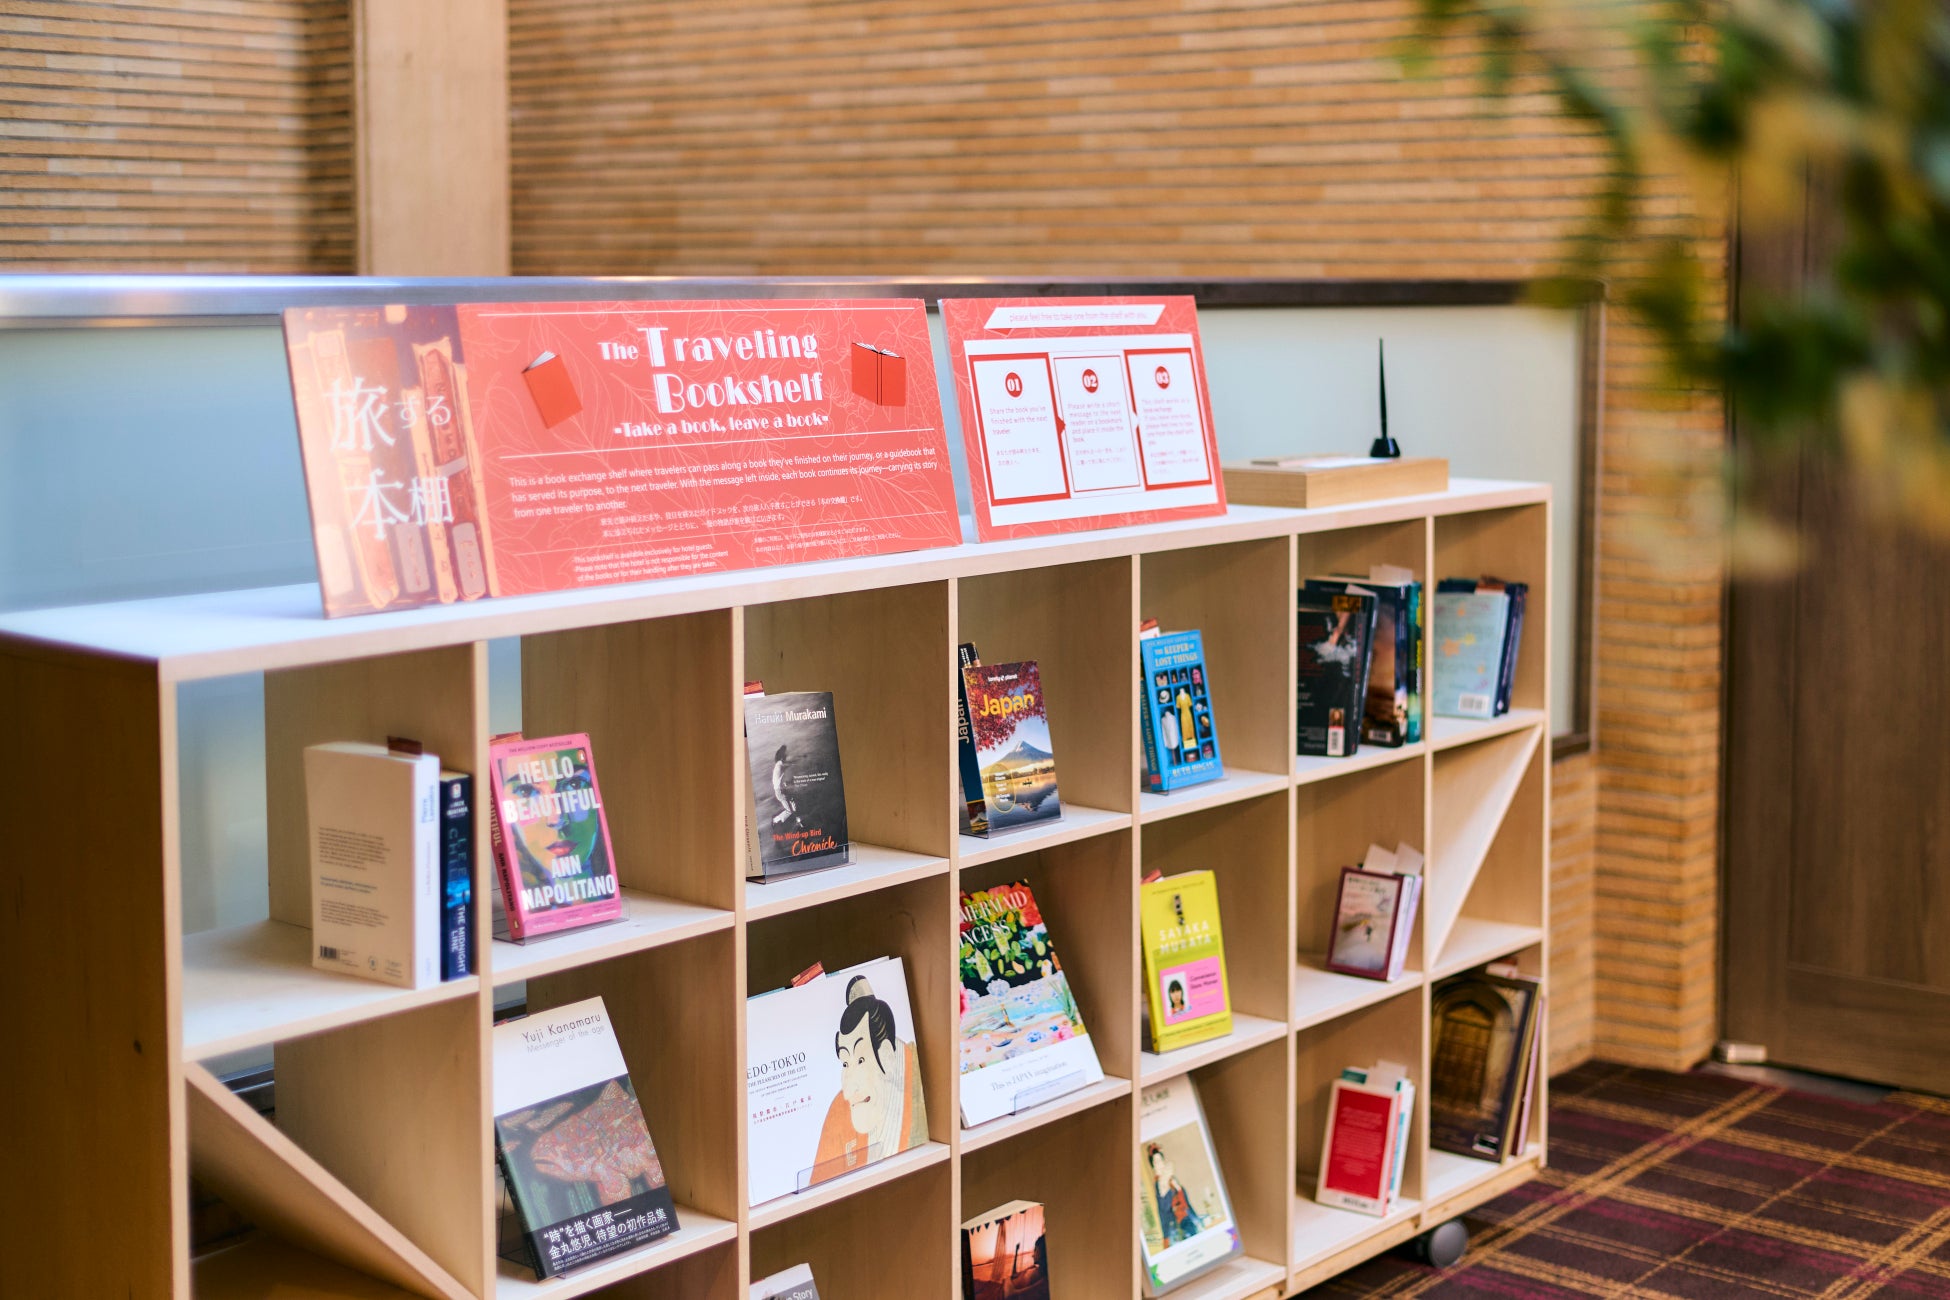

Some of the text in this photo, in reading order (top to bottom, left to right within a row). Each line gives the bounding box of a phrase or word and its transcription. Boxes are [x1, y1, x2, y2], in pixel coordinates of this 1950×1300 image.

[597, 327, 818, 367] The Traveling
[652, 371, 823, 414] Bookshelf
[1007, 378, 1020, 391] 01
[1083, 375, 1097, 388] 02
[323, 376, 451, 452] 旅する
[667, 421, 678, 435] a
[681, 418, 726, 434] book,
[729, 414, 769, 432] leave
[773, 414, 784, 428] a
[510, 447, 935, 487] This is a book exchange shelf where travelers can pass along a book they've finished on their journey, or a guidebook that
[511, 491, 527, 502] has
[528, 489, 556, 500] served
[557, 489, 568, 499] its
[605, 486, 615, 494] to
[616, 484, 629, 494] the
[631, 483, 648, 492] next
[649, 480, 679, 491] traveler.
[680, 478, 698, 488] With
[699, 477, 711, 487] the
[713, 476, 744, 486] message
[745, 473, 757, 483] left
[758, 472, 781, 482] inside,
[782, 470, 798, 480] each
[798, 469, 816, 479] book
[817, 466, 849, 477] continues
[850, 466, 858, 474] its
[923, 460, 937, 471] story
[343, 467, 454, 540] 本棚
[514, 500, 627, 518] from one traveler to another.
[631, 559, 644, 567] hotel
[661, 555, 691, 564] responsible
[709, 551, 728, 559] content
[681, 544, 695, 553] hotel
[1155, 652, 1198, 667] LOST THINGS
[1164, 643, 1189, 655] KEEPER
[755, 706, 827, 724] Haruki Murakami
[980, 694, 1034, 719] Japan
[518, 756, 575, 785] HELLO
[502, 788, 601, 823] BEAUTIFUL
[773, 828, 822, 841] The Wind-up Bird
[457, 838, 467, 876] LEE
[791, 836, 838, 857] Chronicle
[551, 854, 582, 878] ANN
[521, 874, 616, 911] NAPOLITANO
[451, 930, 459, 953] LINE
[457, 904, 466, 973] THE MIDNIGHT
[1159, 920, 1209, 941] SAYAKA
[1160, 933, 1212, 954] MURATA
[522, 1014, 601, 1043] Yuji Kanamaru
[527, 1037, 565, 1053] Messenger
[569, 1031, 576, 1041] of
[577, 1029, 589, 1038] the
[793, 1288, 813, 1300] Story
